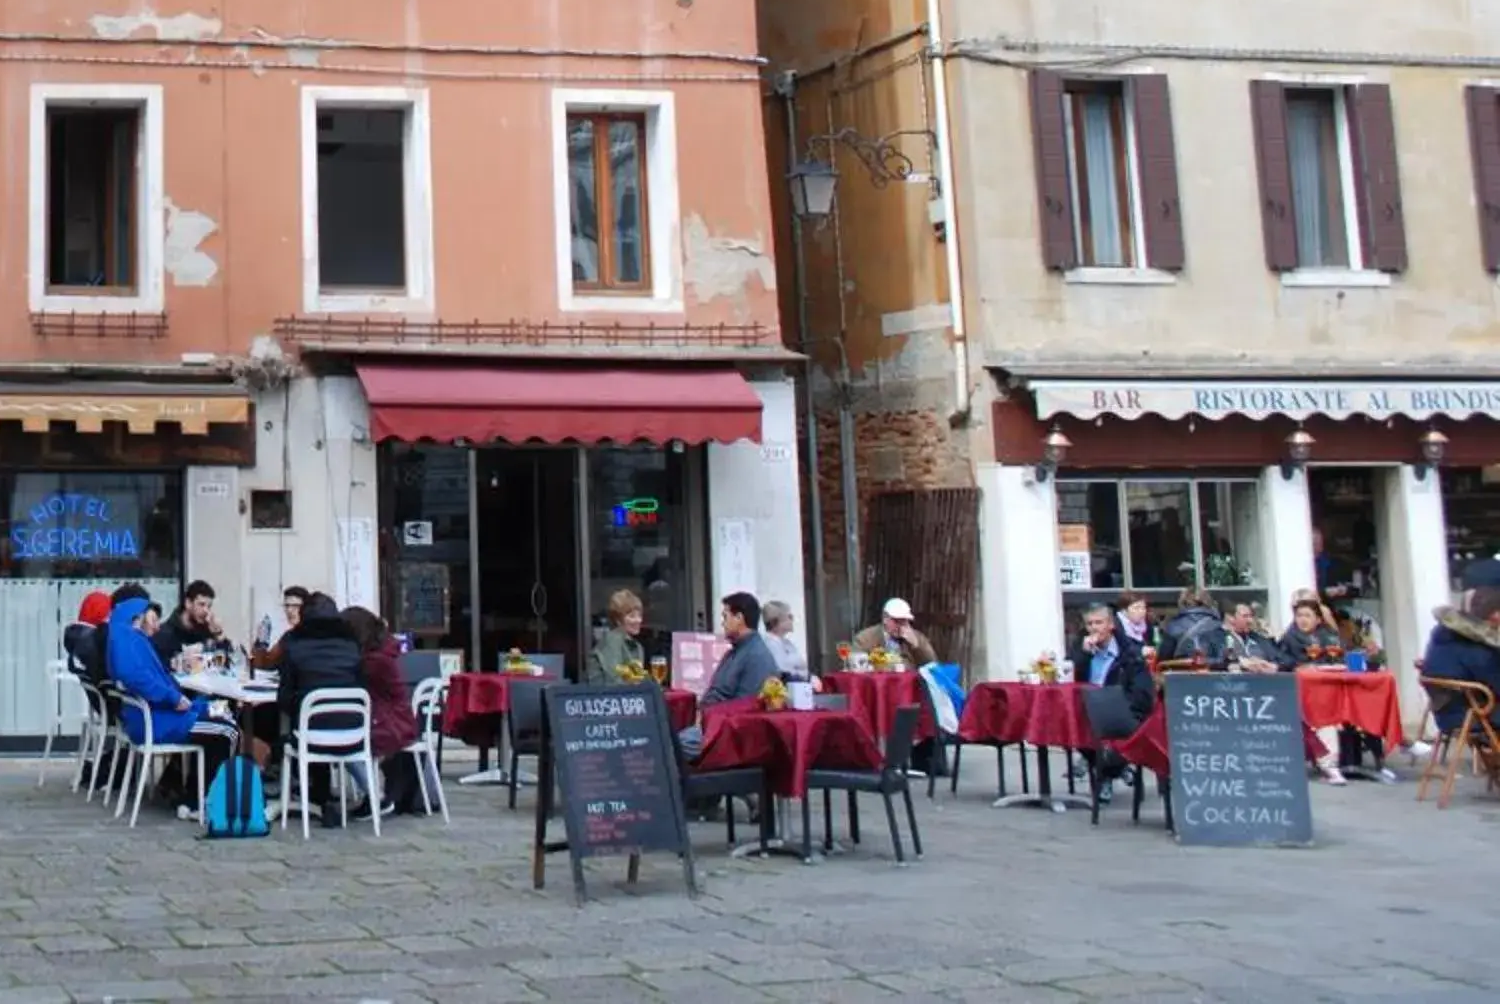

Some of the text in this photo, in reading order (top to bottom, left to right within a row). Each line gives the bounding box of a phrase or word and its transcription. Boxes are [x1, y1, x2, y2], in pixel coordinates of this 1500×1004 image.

[1092, 389, 1142, 410] BAR
[1194, 388, 1350, 410] RISTORANTE
[1367, 392, 1394, 409] AL
[30, 495, 111, 525] HOTEL
[621, 696, 646, 714] BAR
[1182, 695, 1275, 720] SPRITZ
[1180, 753, 1243, 773] BEER
[1181, 777, 1247, 797] WINE
[1185, 800, 1296, 825] COCKTAIL
